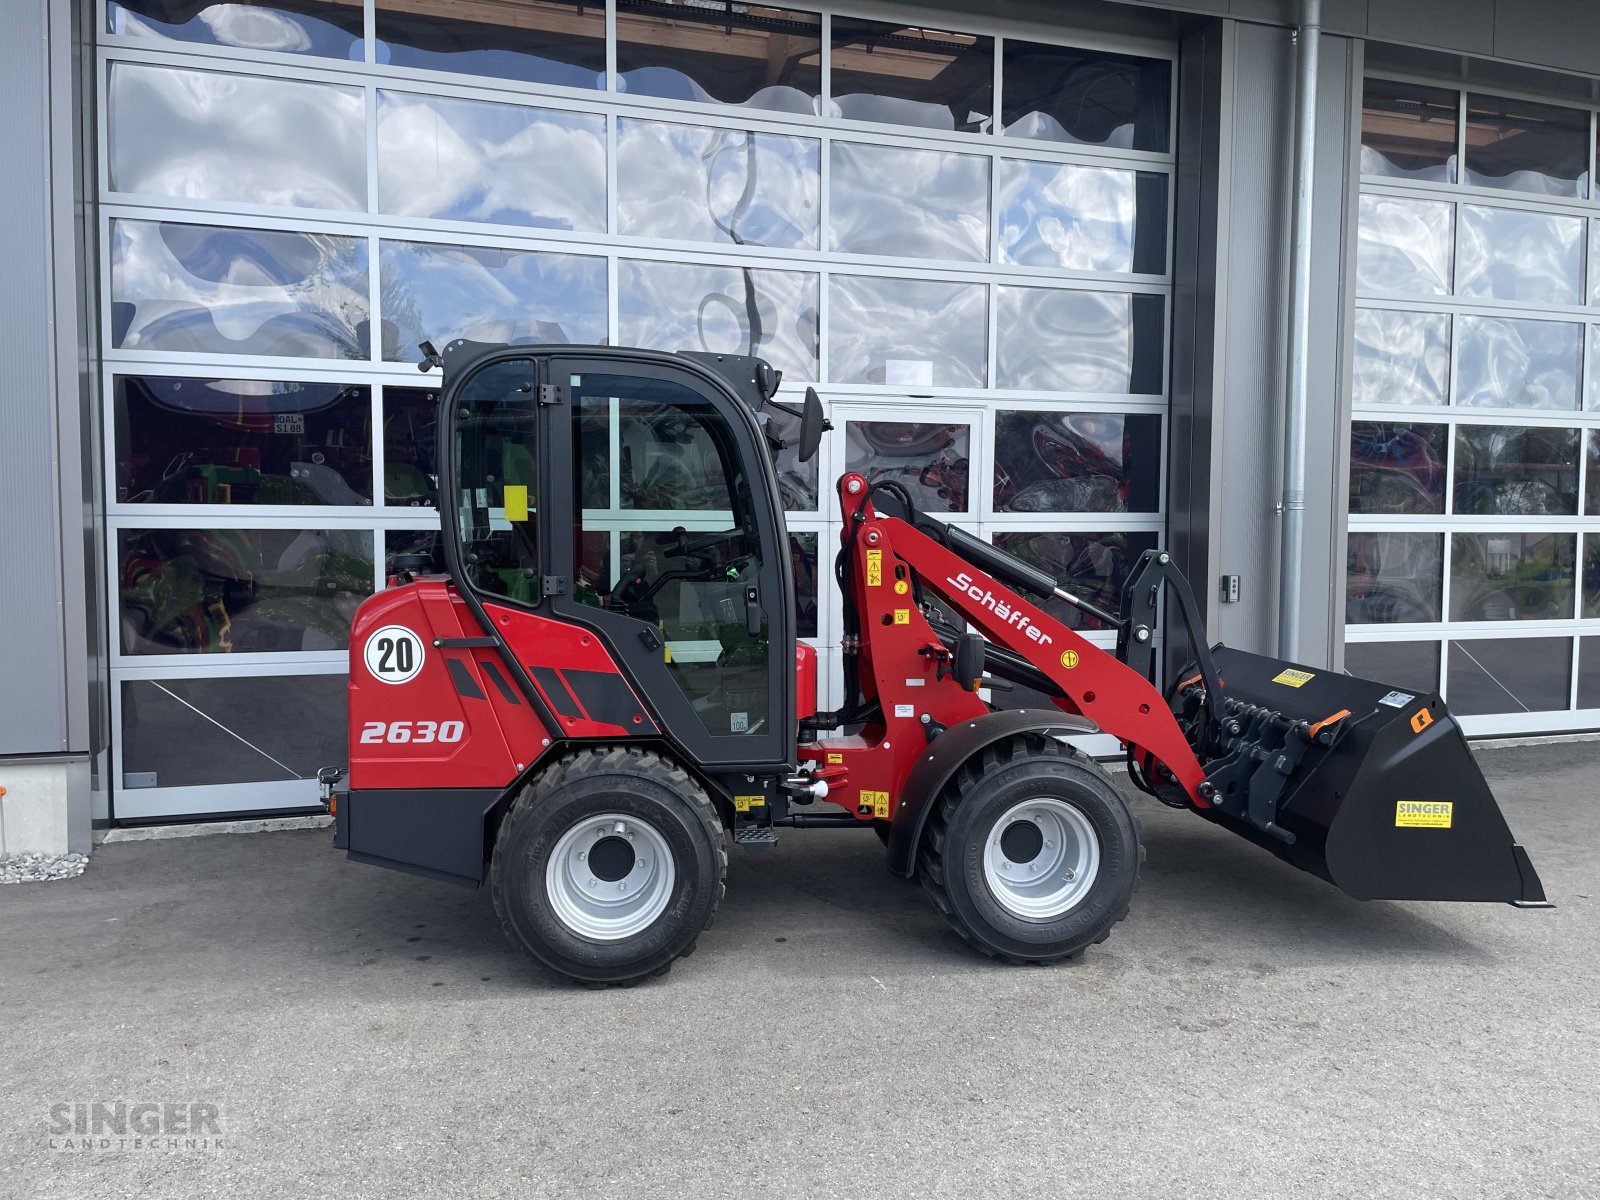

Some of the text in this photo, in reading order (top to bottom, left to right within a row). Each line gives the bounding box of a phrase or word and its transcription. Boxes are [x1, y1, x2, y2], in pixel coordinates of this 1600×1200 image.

[946, 572, 1053, 646] Schäffer
[377, 637, 414, 673] 20
[359, 720, 465, 744] 2630
[1399, 803, 1450, 814] SINGER
